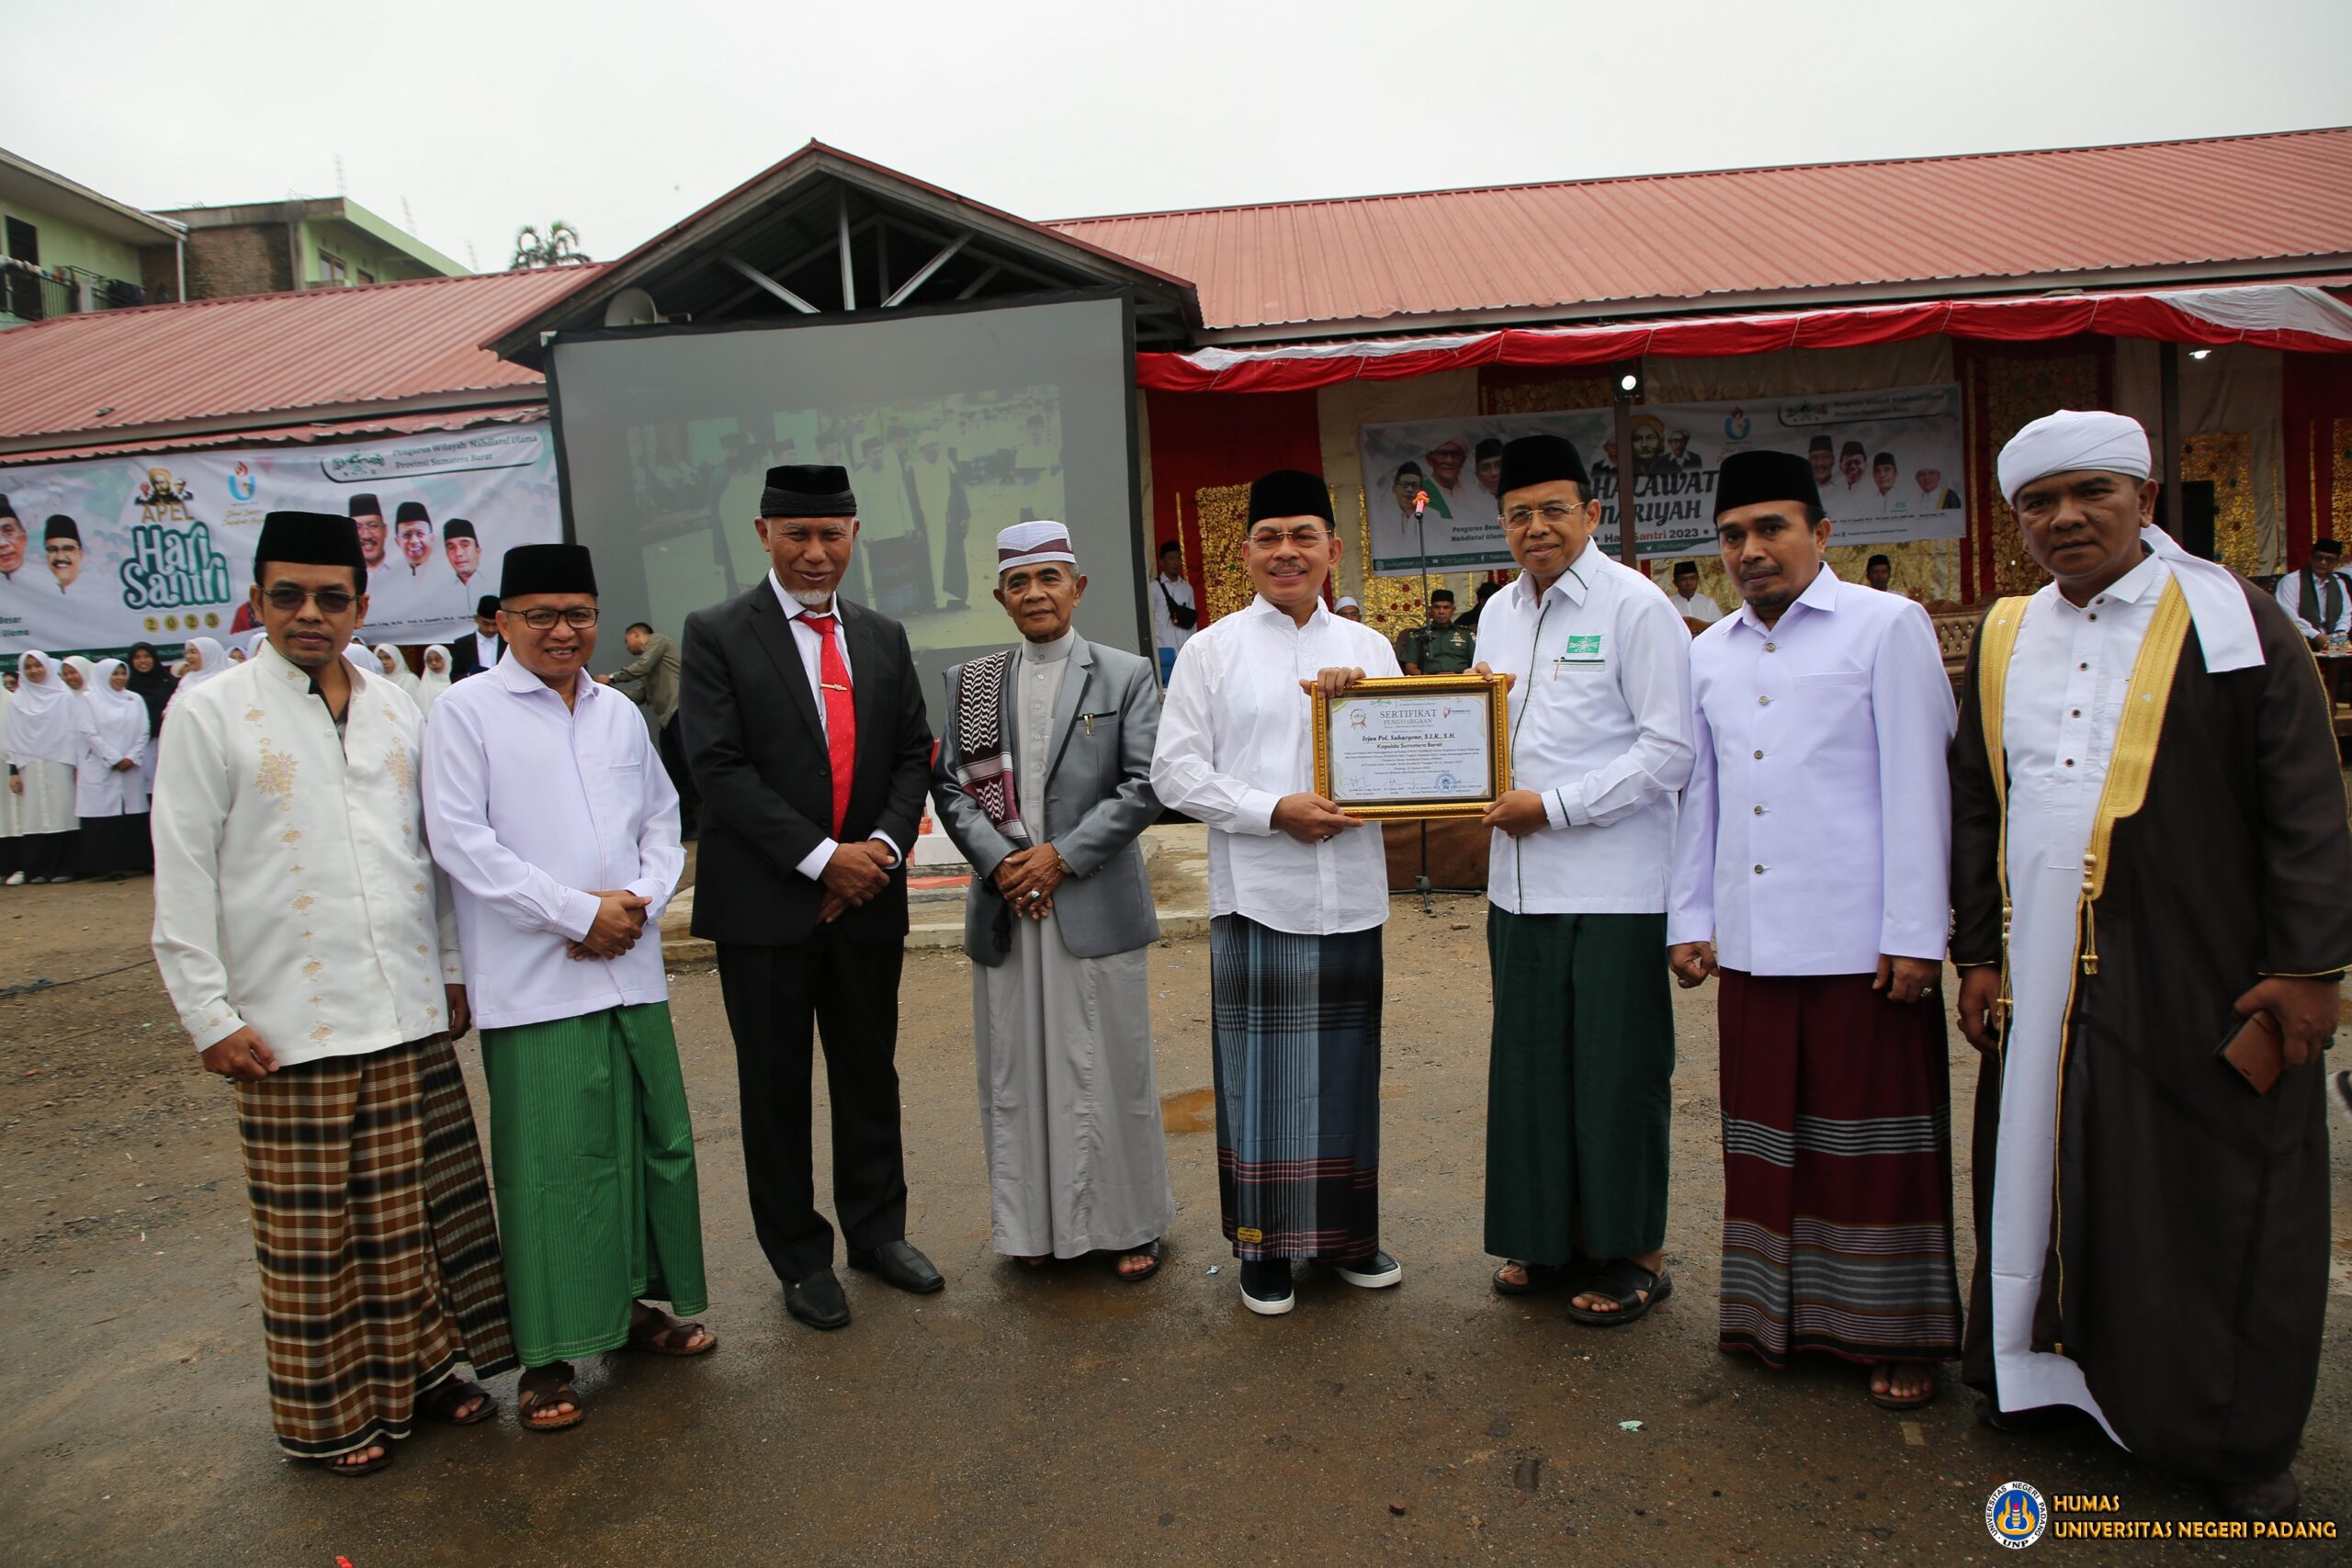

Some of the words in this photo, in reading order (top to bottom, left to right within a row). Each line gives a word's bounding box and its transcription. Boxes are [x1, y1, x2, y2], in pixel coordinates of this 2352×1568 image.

[432, 442, 467, 453] Wilayah
[1593, 470, 1719, 500] HLAWAT
[141, 502, 195, 523] APEL
[1604, 534, 1622, 544] Ha
[1669, 528, 1699, 539] 2023
[133, 522, 210, 577] Hari
[121, 555, 230, 607] Santri
[145, 613, 218, 631] 2023
[1379, 708, 1439, 719] SERTIFIKAT
[1384, 717, 1433, 726] PENGHARGAAN
